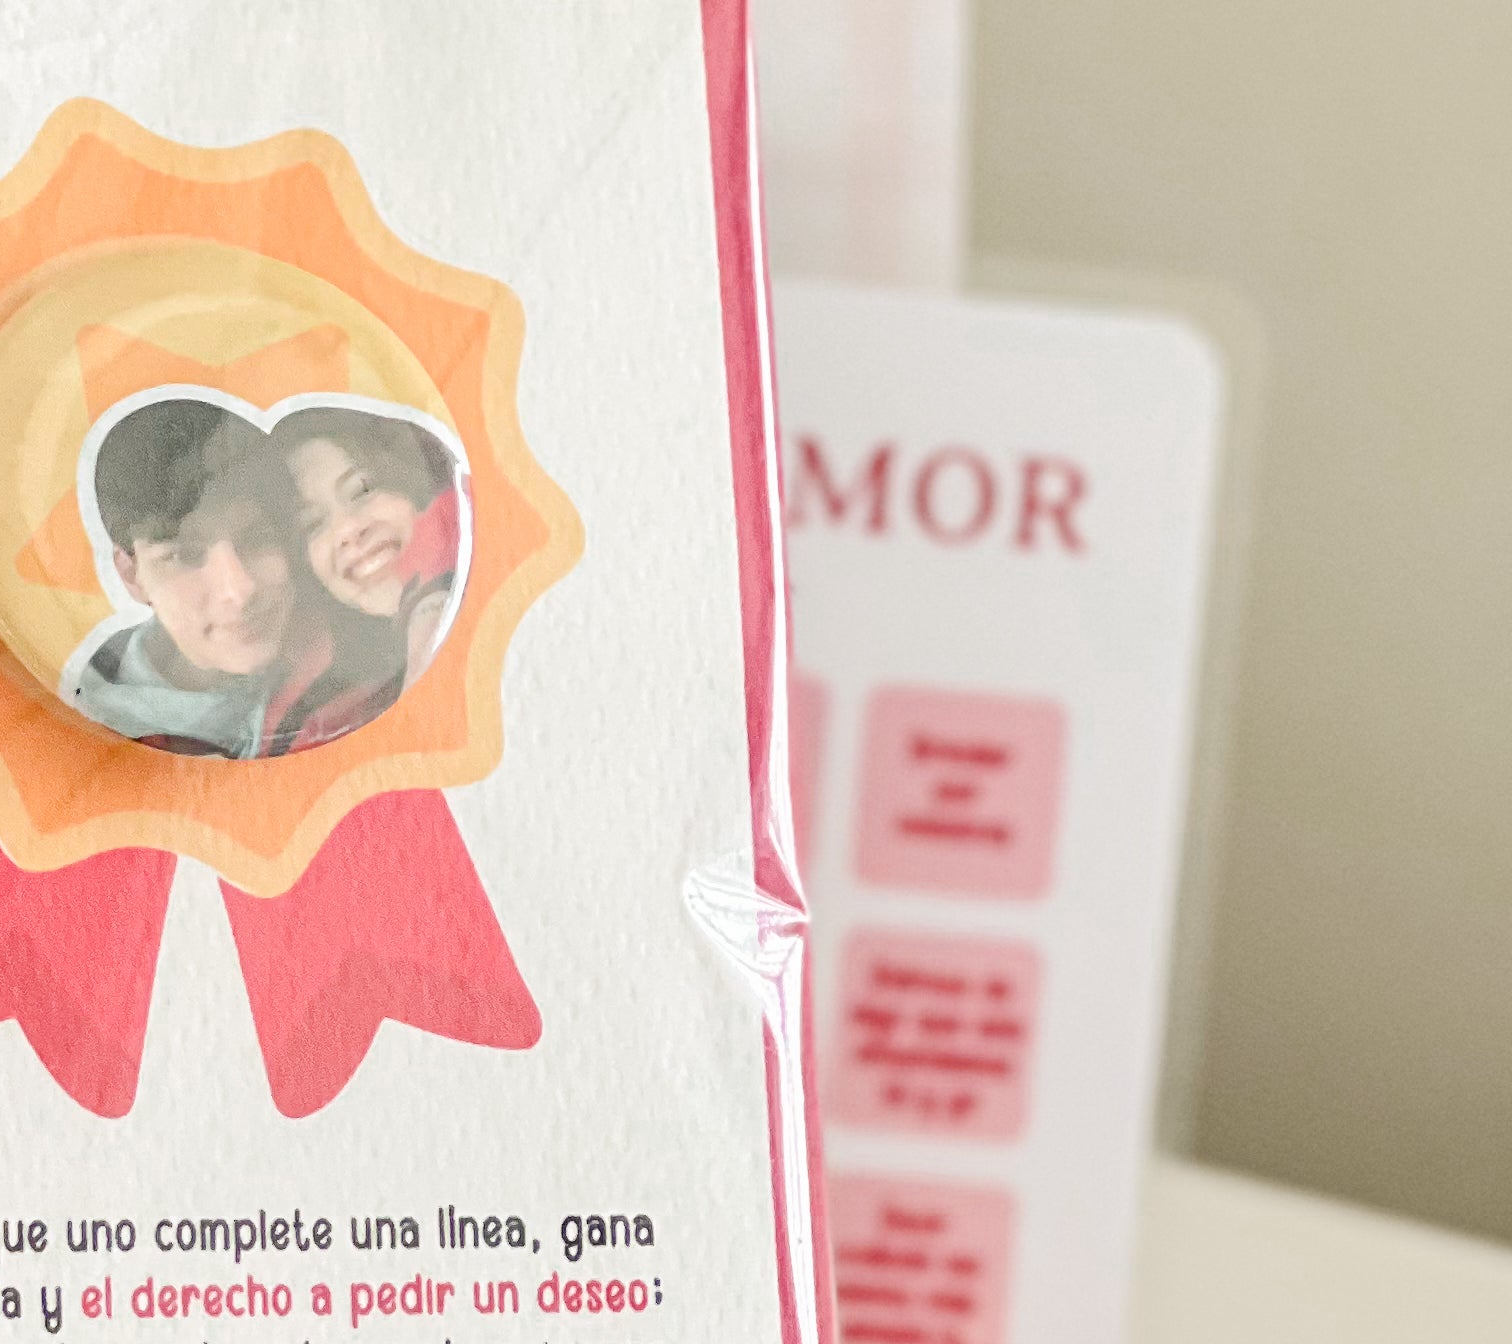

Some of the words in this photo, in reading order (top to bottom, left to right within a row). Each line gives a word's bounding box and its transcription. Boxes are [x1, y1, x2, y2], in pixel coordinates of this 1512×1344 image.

[788, 430, 1090, 556] MOR
[68, 1220, 135, 1252] uno
[155, 1209, 332, 1263] complete
[351, 1218, 420, 1250] una
[561, 1215, 654, 1262] gana
[41, 1286, 63, 1334] y
[81, 1276, 113, 1318] el
[131, 1275, 292, 1317] derecho
[311, 1283, 332, 1316] a
[350, 1273, 455, 1329] pedir
[473, 1281, 519, 1314] un
